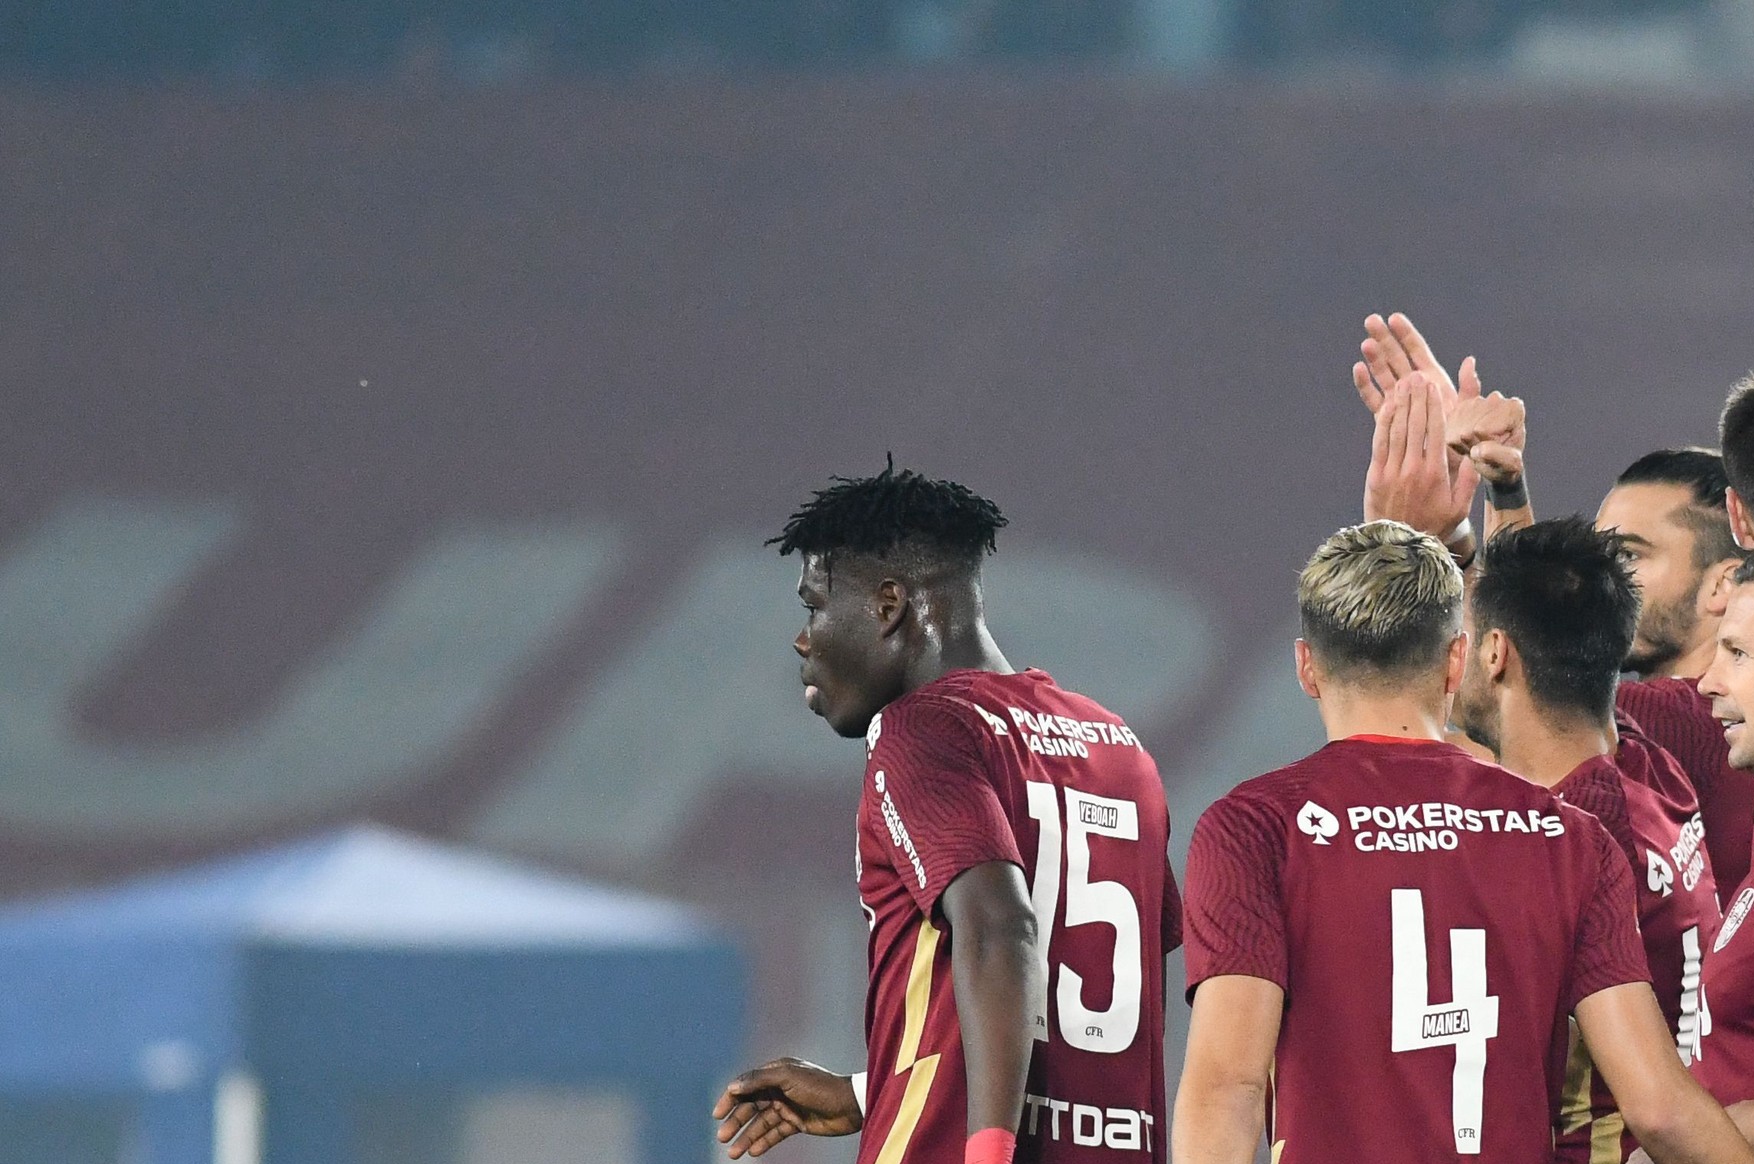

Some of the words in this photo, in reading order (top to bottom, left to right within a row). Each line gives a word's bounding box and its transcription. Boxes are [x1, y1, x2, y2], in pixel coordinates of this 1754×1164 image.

[1007, 706, 1145, 753] POKERSTAR
[1079, 801, 1118, 829] YEBOAH
[1354, 830, 1460, 854] CASINO
[1026, 779, 1140, 1054] 15
[1085, 1025, 1104, 1039] CFR
[1391, 888, 1500, 1155] 4
[1422, 1009, 1470, 1038] MANEA
[1026, 1093, 1070, 1141] TT
[1457, 1126, 1477, 1140] CFR
